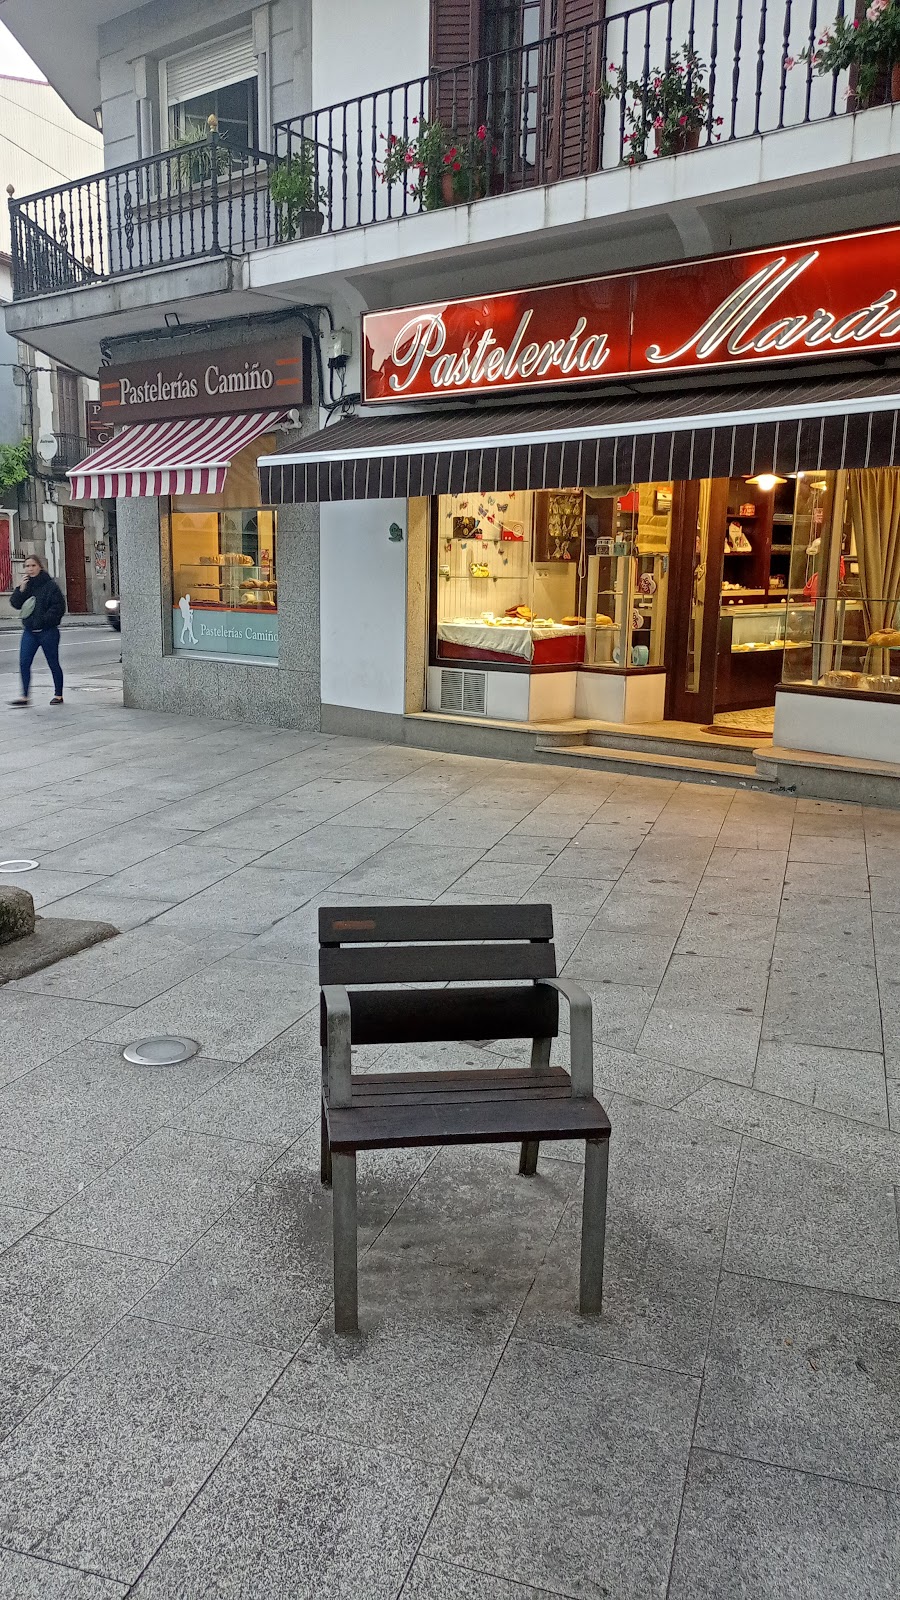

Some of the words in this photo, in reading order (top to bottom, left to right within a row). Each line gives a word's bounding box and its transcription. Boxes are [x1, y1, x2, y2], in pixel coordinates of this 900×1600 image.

[390, 308, 611, 392] Pastelería
[118, 371, 199, 406] Pastelerías
[204, 361, 275, 396] Camiño
[200, 623, 243, 639] Pastelerías
[245, 627, 279, 642] Camiño
